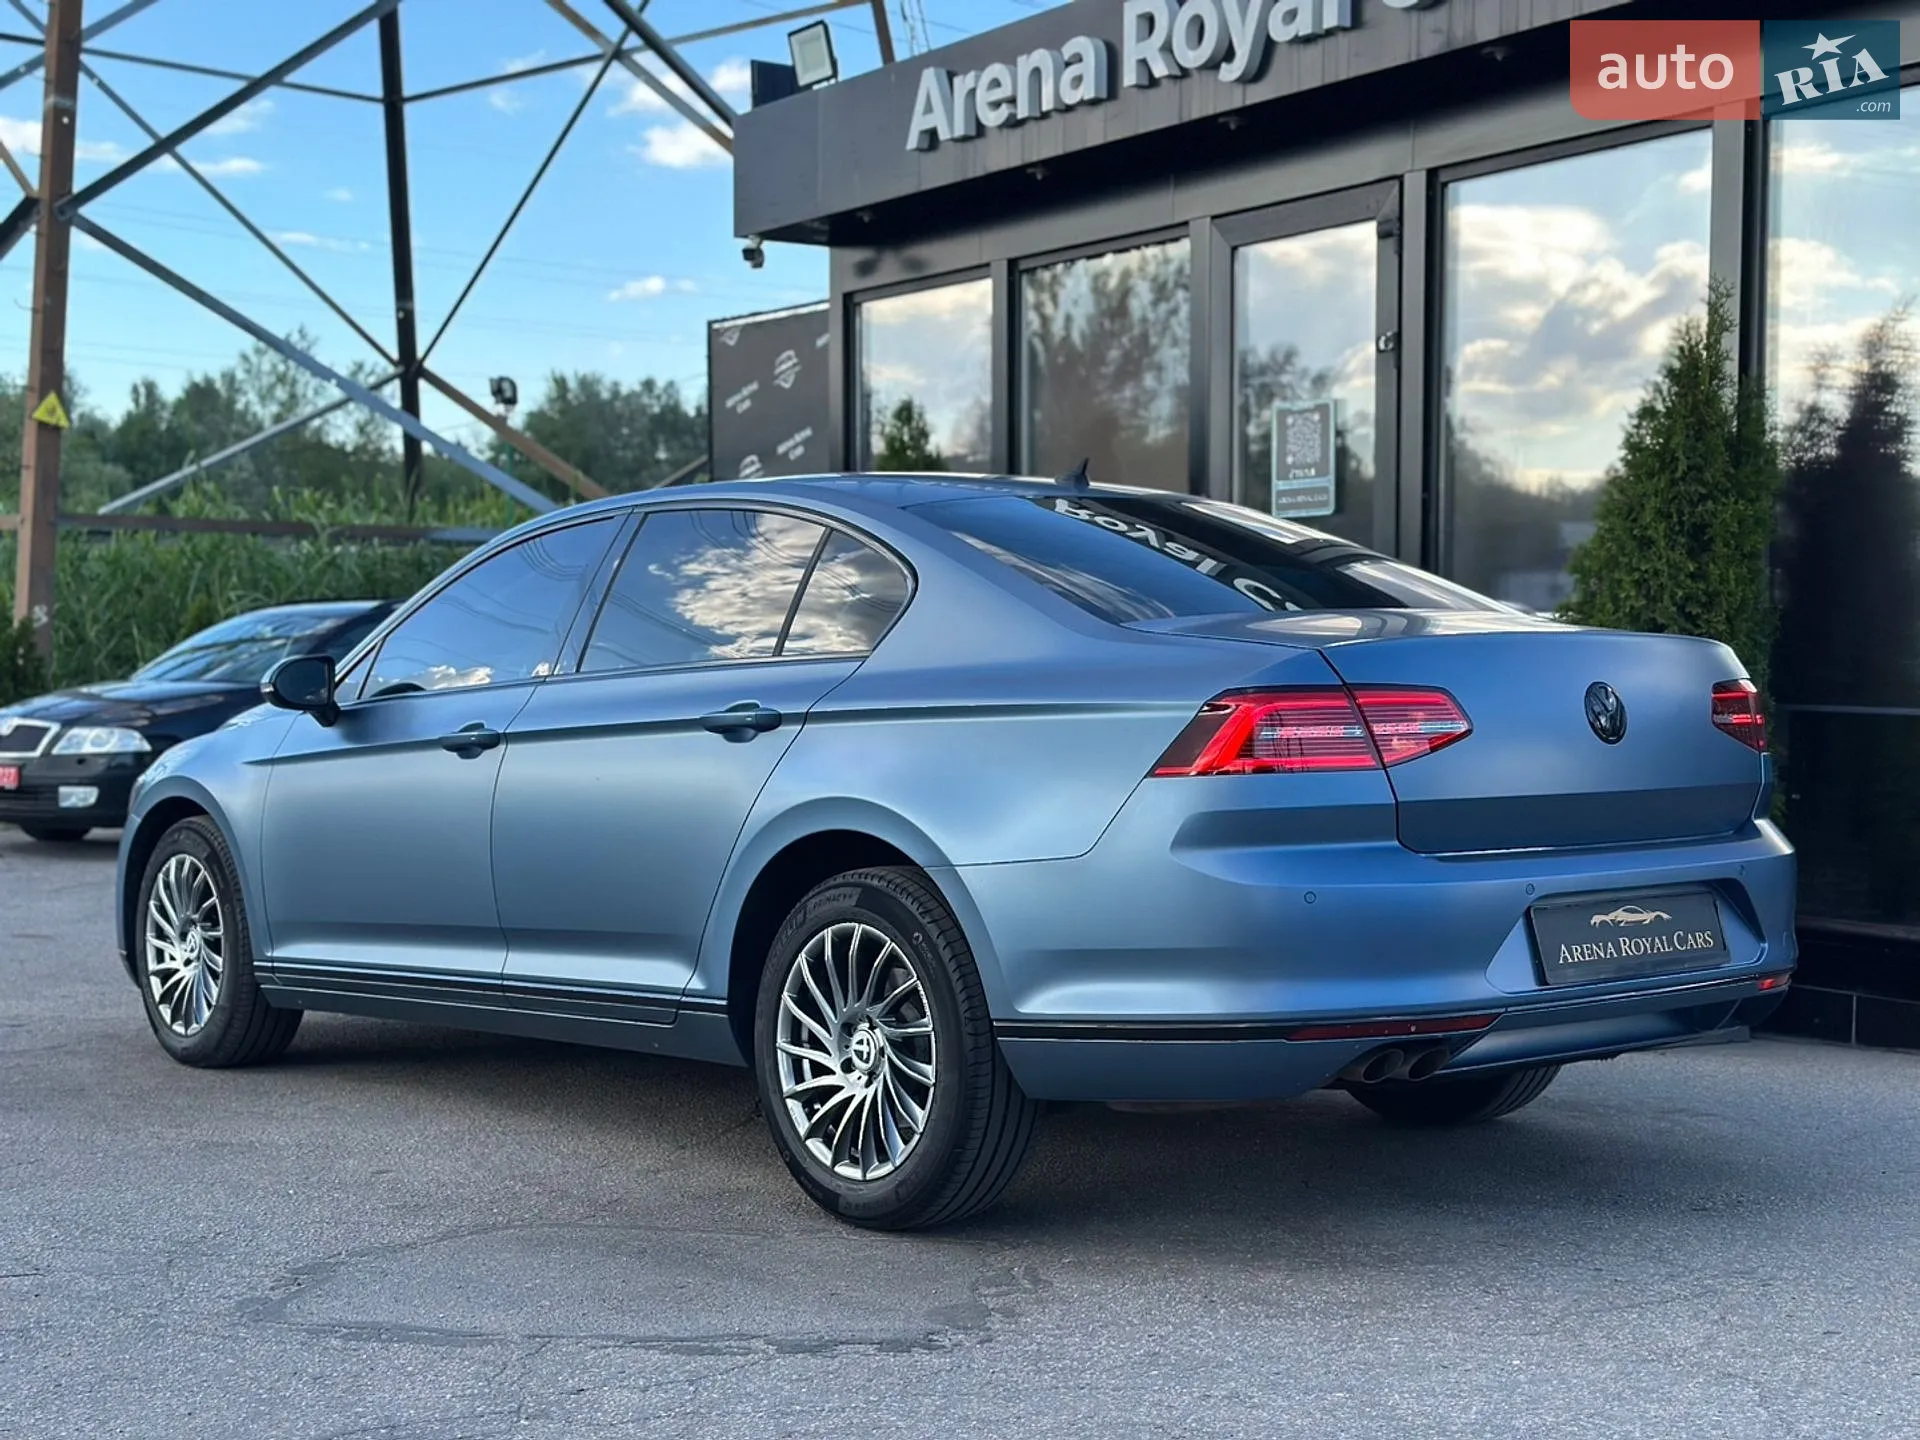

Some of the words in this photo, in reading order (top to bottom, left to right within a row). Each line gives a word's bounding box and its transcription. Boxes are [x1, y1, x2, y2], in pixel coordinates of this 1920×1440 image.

[906, 35, 1109, 151] Arena
[1558, 941, 1618, 965] ARENA
[1618, 936, 1673, 957] ROYAL
[1673, 930, 1714, 951] CARS
